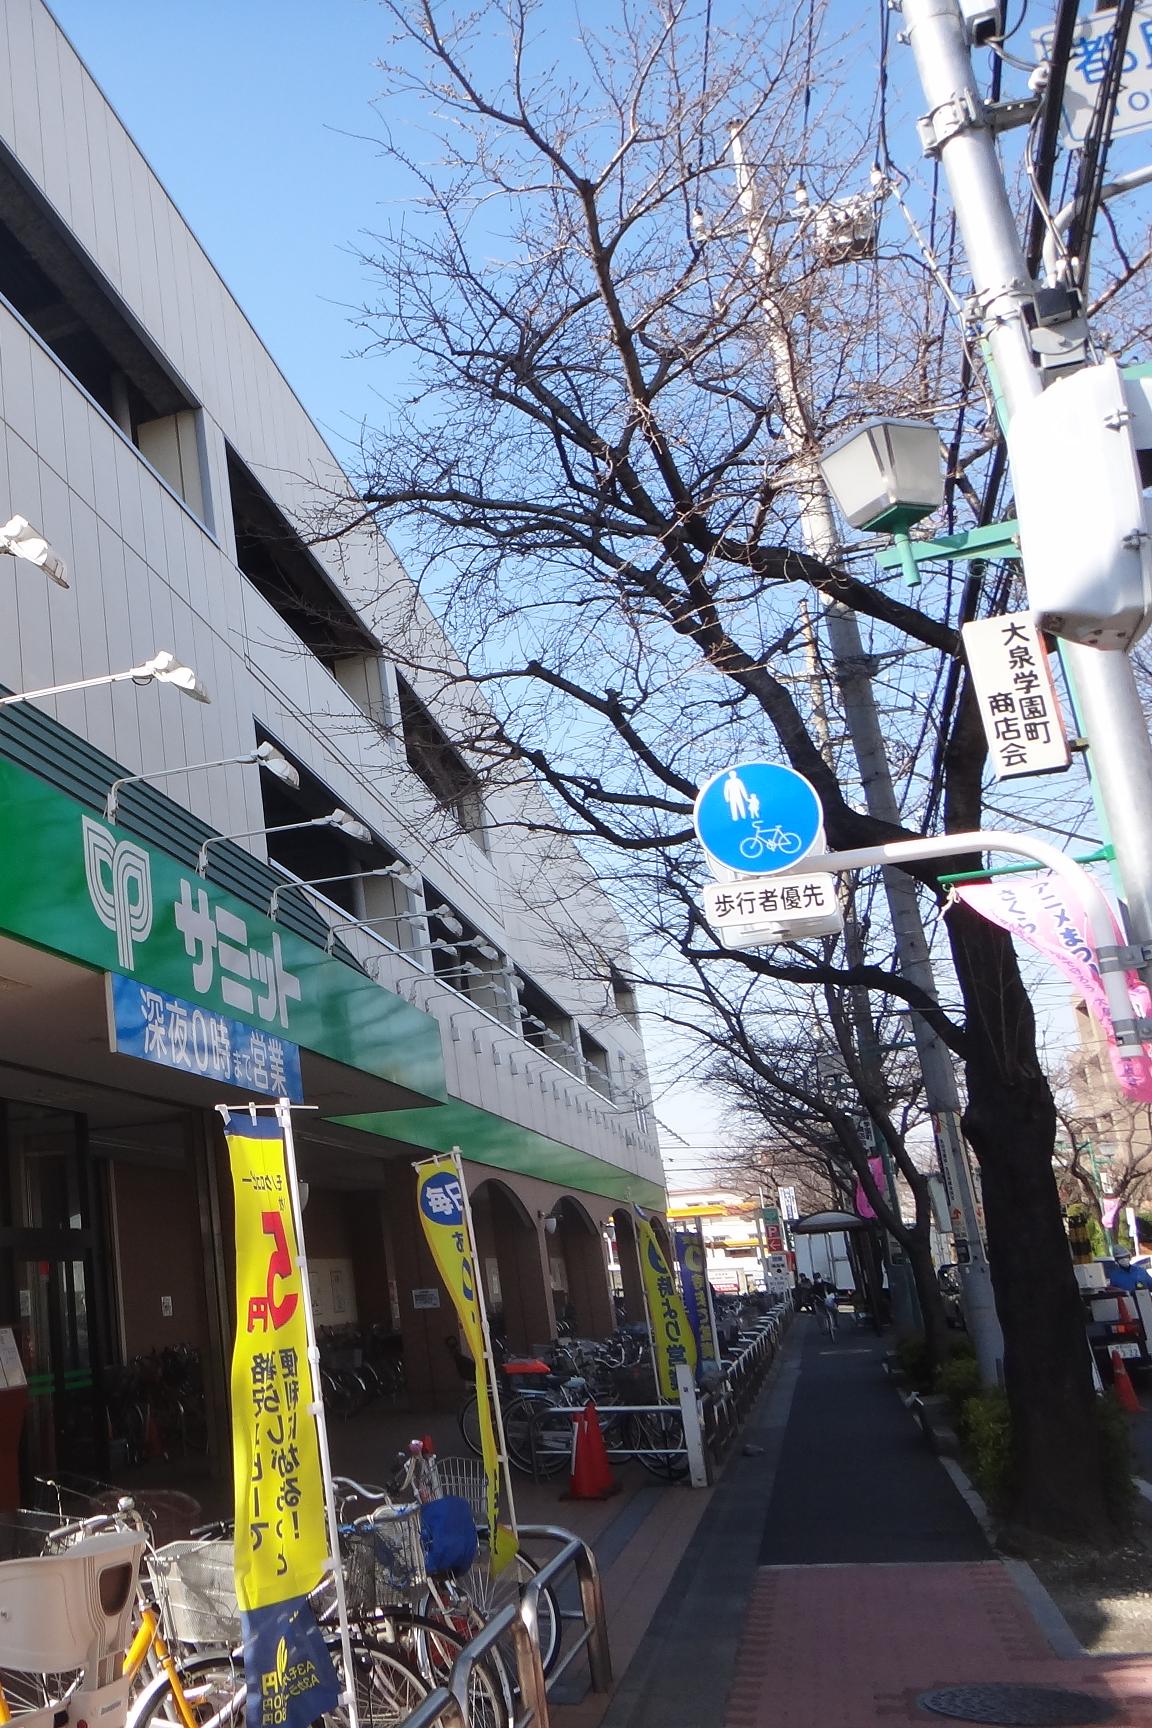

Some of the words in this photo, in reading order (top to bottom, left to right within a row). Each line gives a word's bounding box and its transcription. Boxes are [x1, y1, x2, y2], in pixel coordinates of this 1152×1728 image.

[1001, 621, 1051, 744] 大泉学園町
[987, 691, 1028, 767] 商店会
[714, 883, 825, 918] 歩行者優先
[997, 889, 1037, 934] さくら
[174, 878, 302, 1030] サミット
